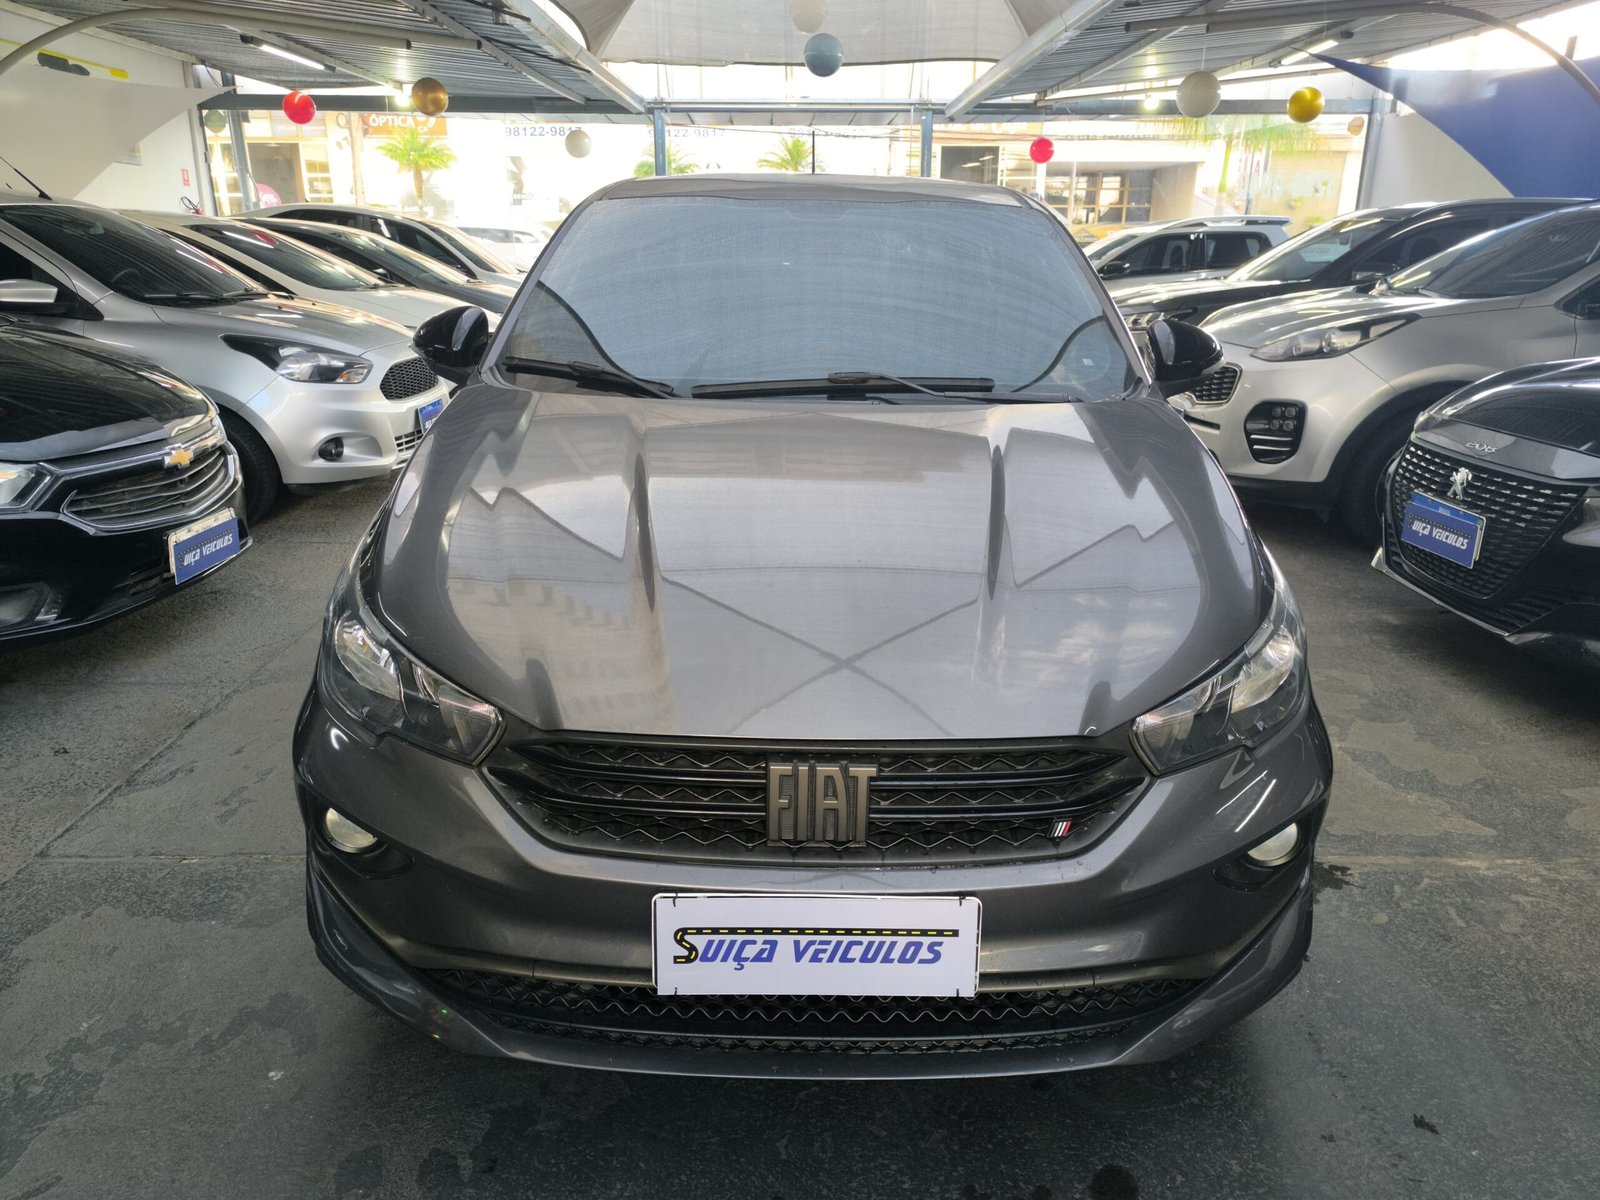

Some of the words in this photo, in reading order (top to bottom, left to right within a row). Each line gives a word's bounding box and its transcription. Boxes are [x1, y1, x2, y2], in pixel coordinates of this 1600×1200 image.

[648, 128, 726, 138] 9122-9817
[1432, 526, 1469, 550] VEICULOS
[768, 763, 878, 847] FIAT
[673, 927, 778, 971] SUIÇA
[793, 940, 944, 965] VEICULOS
